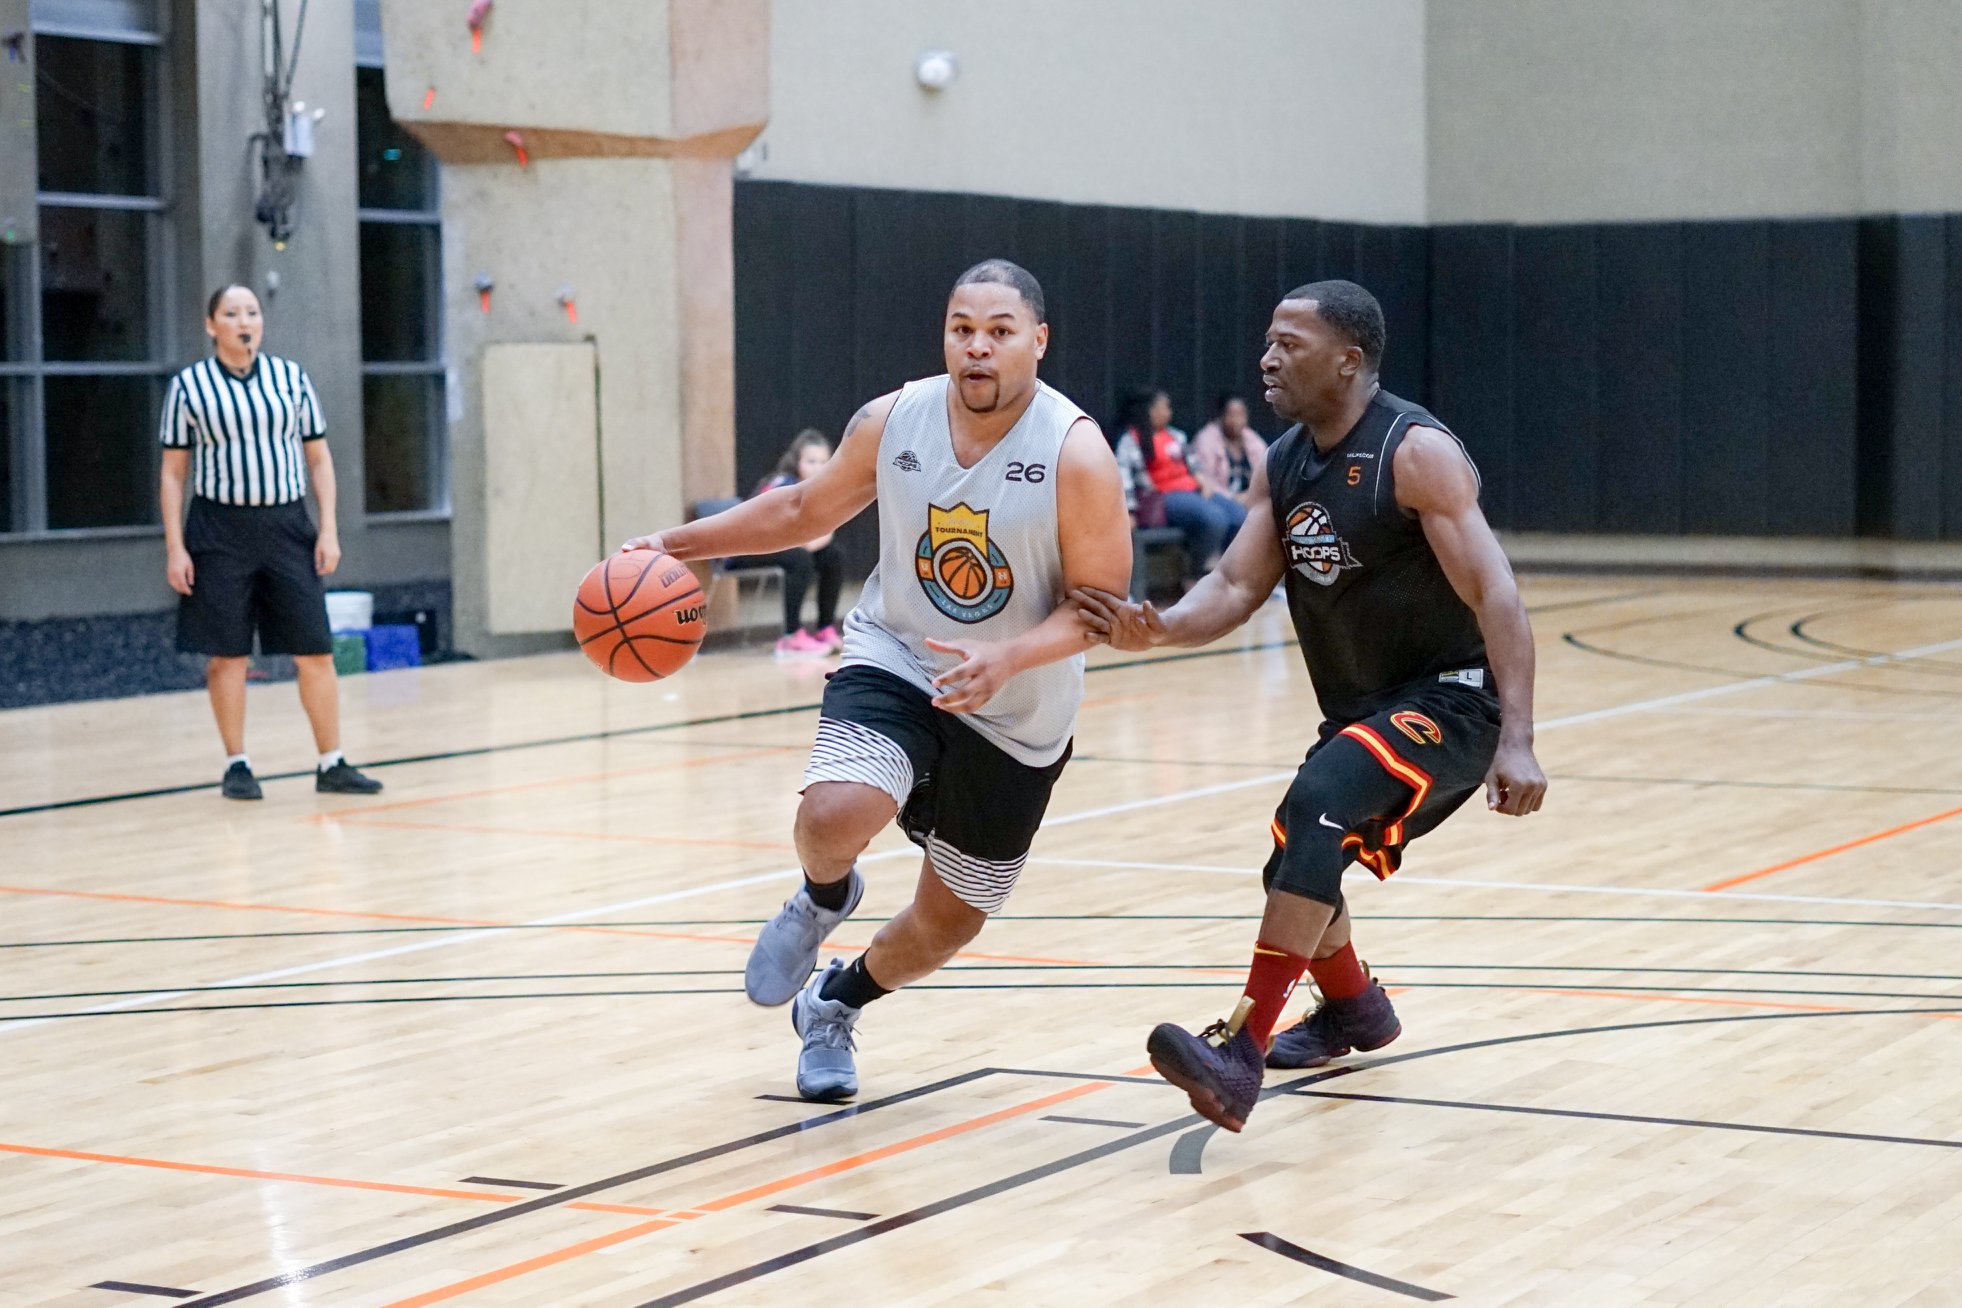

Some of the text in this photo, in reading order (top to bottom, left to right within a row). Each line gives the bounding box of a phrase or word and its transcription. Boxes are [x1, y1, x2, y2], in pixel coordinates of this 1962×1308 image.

[1005, 461, 1047, 484] 26
[1346, 465, 1361, 486] 5
[1290, 545, 1341, 561] HOOPS
